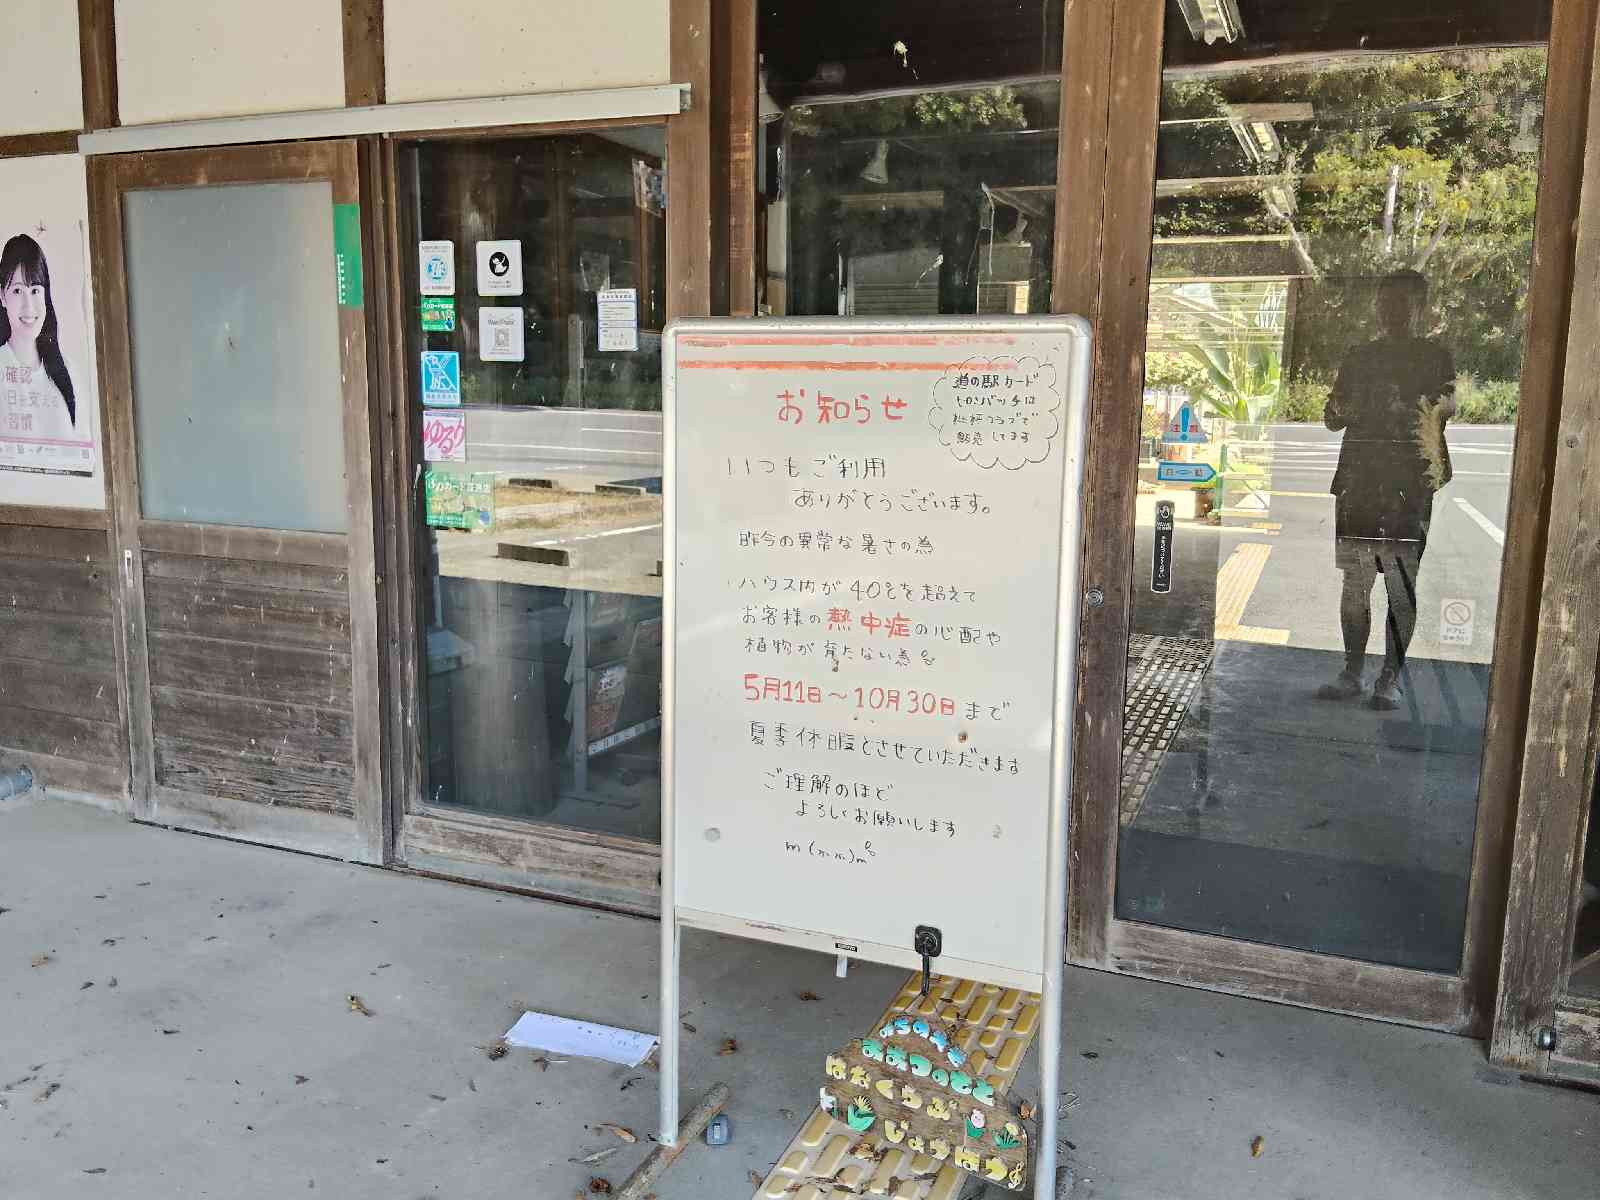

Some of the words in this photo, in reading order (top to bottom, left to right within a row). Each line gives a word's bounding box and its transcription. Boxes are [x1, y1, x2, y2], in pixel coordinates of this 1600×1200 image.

[777, 388, 908, 425] お知らせ
[727, 453, 886, 479] いつもご利用
[792, 488, 991, 514] ありがとうございます。
[738, 529, 936, 555] 昨今の異常な暑さの為
[749, 719, 1020, 775] 夏季休暇とさせていただきます
[763, 767, 895, 802] ご理解のほど
[795, 799, 957, 838] よろしくお願いします
